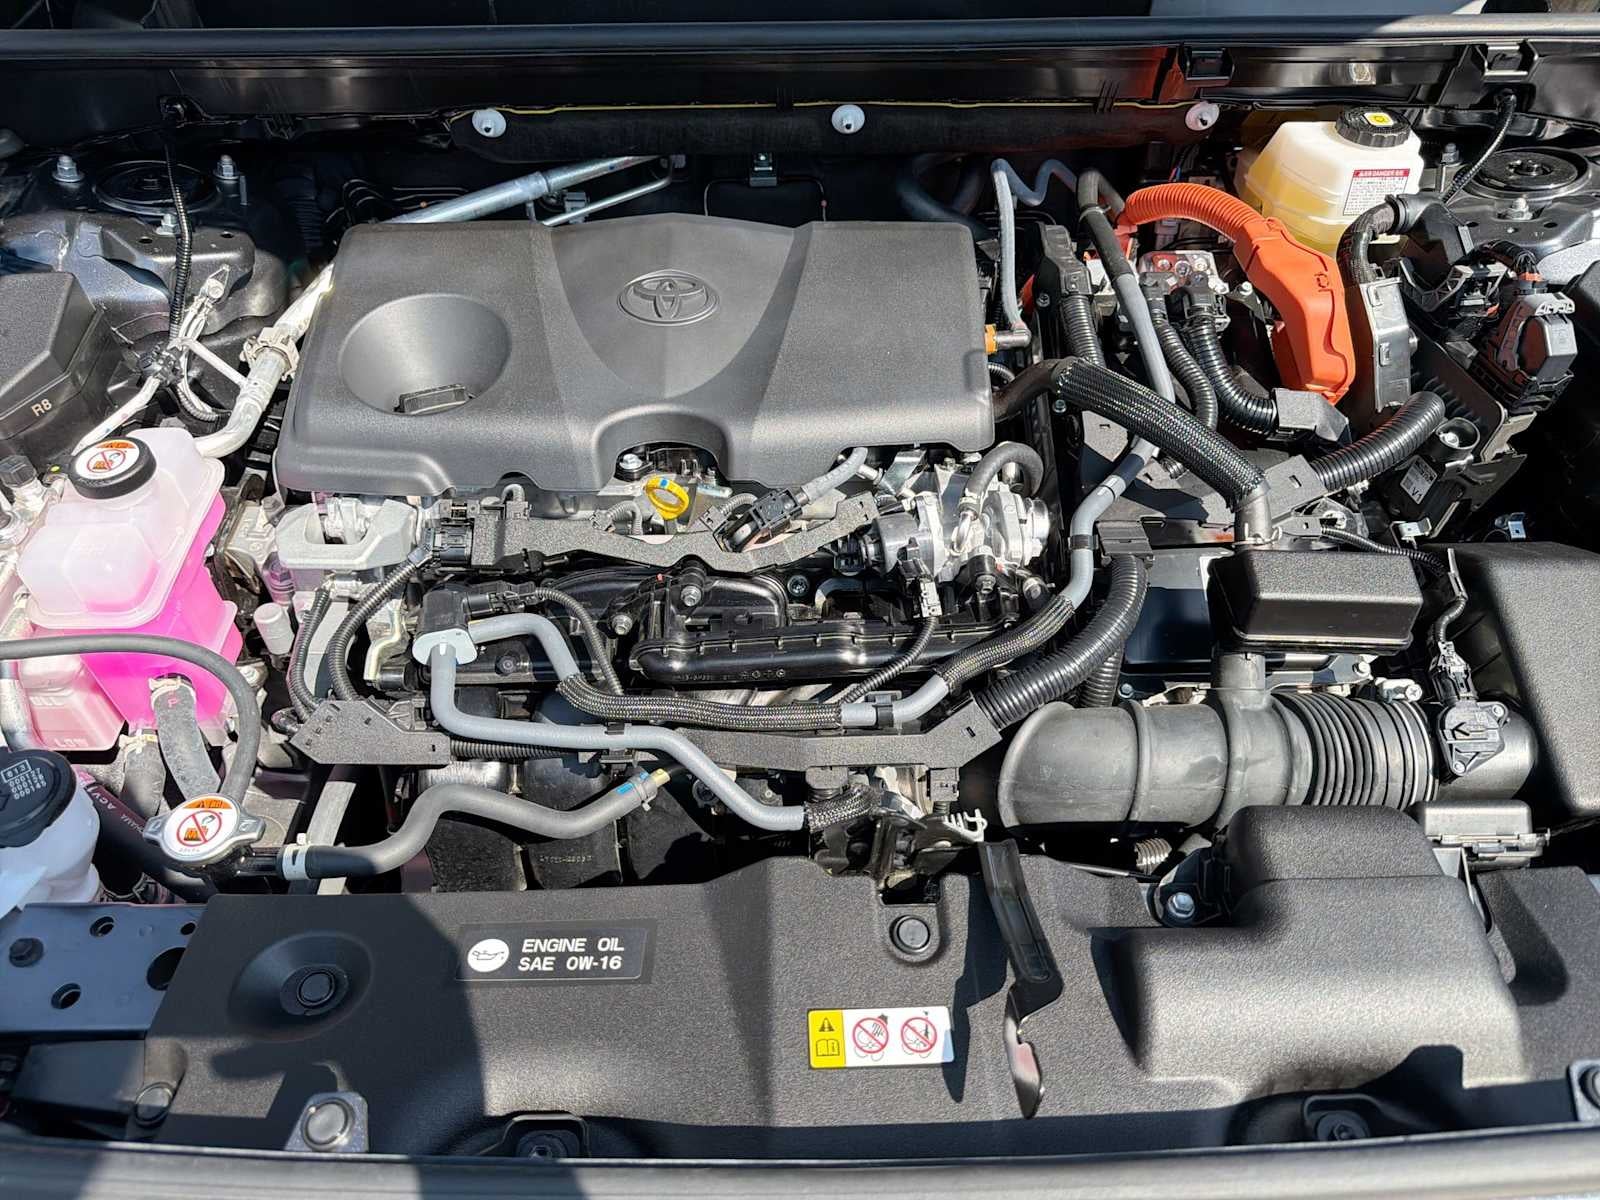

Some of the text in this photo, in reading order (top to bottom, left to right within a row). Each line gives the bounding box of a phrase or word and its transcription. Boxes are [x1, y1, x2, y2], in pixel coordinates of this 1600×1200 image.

[31, 398, 52, 417] R8
[521, 937, 625, 953] ENGINE OIL
[518, 956, 556, 972] SAE
